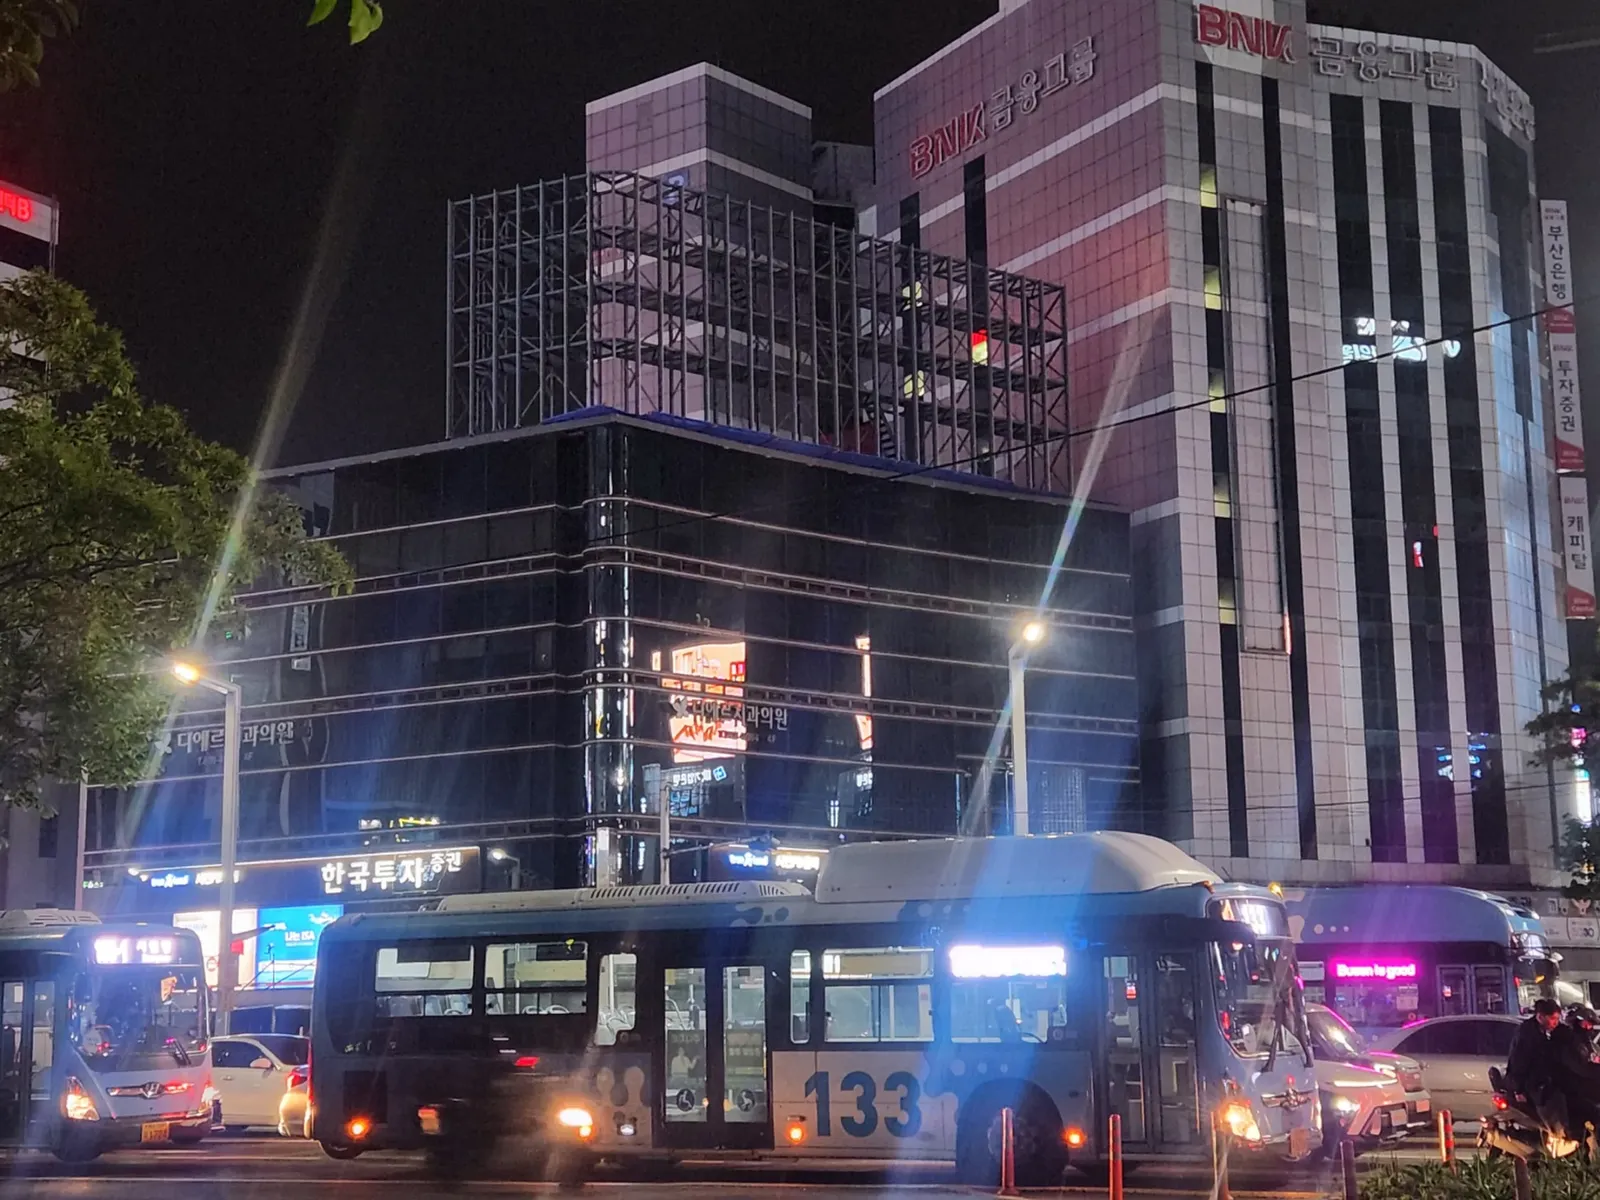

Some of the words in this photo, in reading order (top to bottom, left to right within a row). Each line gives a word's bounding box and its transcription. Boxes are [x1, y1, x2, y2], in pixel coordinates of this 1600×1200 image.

[1196, 4, 1297, 64] BNK
[1312, 35, 1460, 92] 금융그룹
[909, 101, 988, 181] BNK
[989, 35, 1098, 132] 금융그룹
[1546, 225, 1567, 300] 부산은행
[1556, 360, 1577, 433] 투자증권
[1567, 515, 1587, 570] 캐피탈
[176, 721, 295, 754] 디에르과의원
[691, 698, 789, 731] 디에르치과의원
[321, 851, 462, 894] 한국투자증권
[1336, 963, 1373, 977] Busan
[1374, 963, 1386, 977] is
[1386, 963, 1416, 980] good
[804, 1070, 923, 1138] 133
